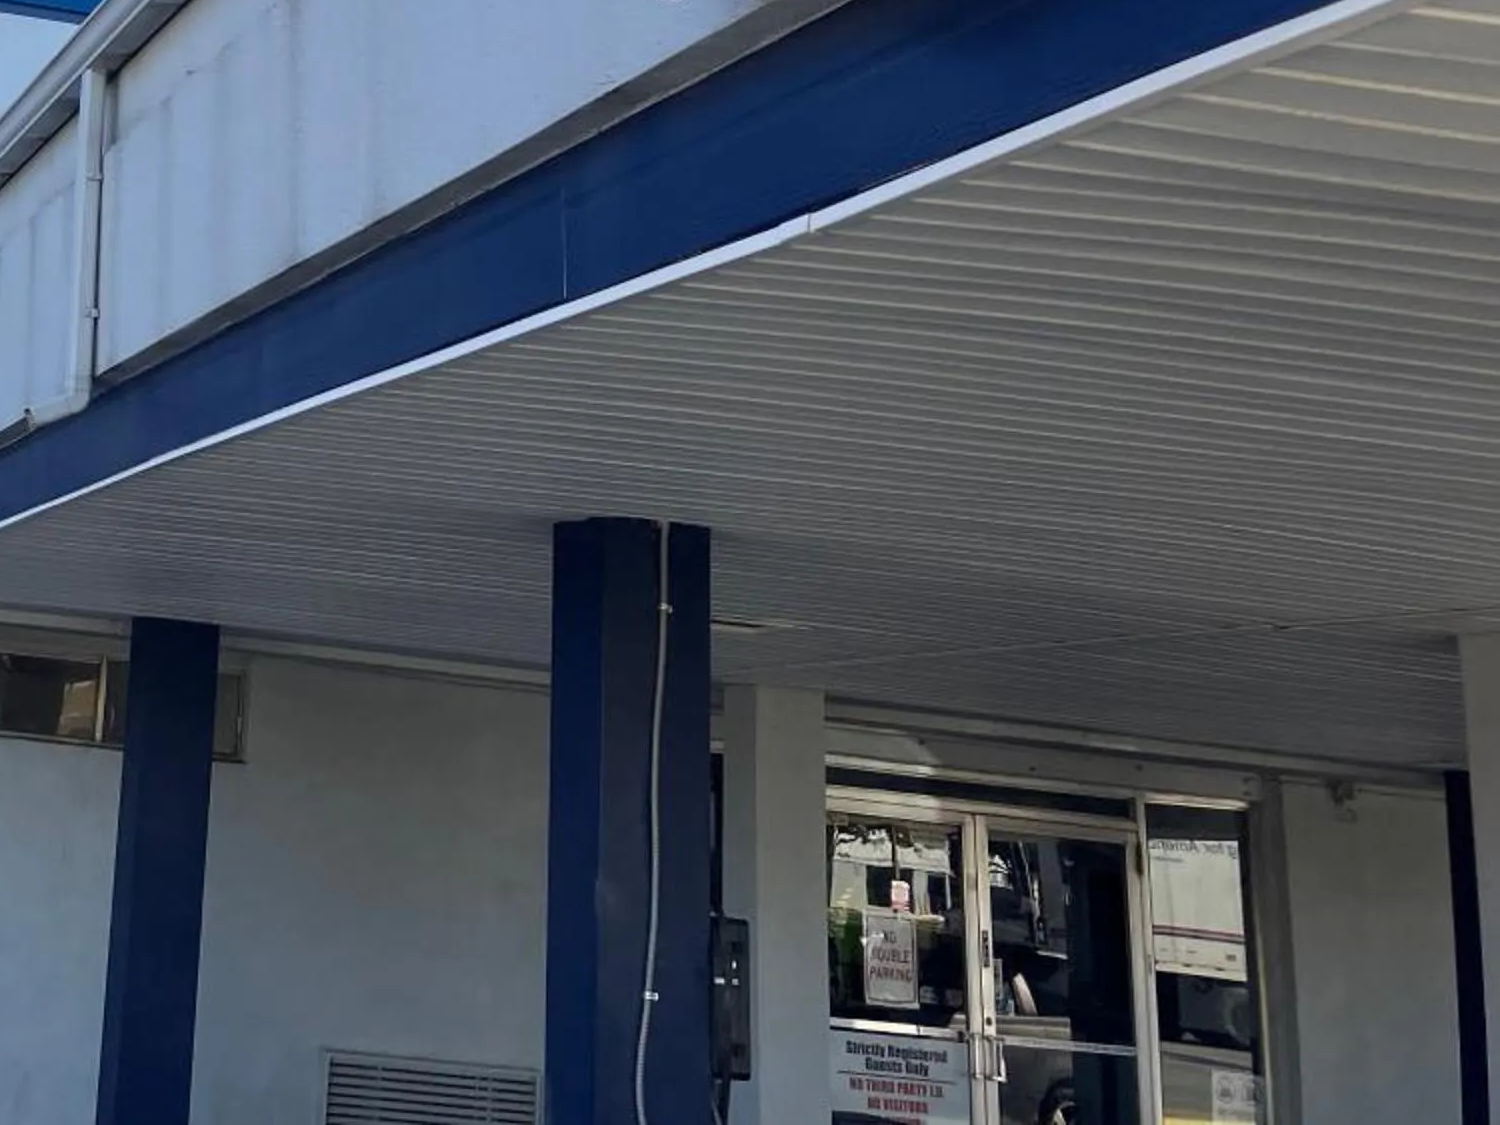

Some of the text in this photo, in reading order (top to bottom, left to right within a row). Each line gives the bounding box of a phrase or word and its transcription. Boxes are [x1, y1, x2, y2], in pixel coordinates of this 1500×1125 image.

[869, 966, 912, 982] PARKING
[846, 1040, 948, 1063] Strictly Registered
[865, 1056, 930, 1077] Guests Only
[849, 1076, 864, 1091] NO
[865, 1078, 895, 1094] THIRD
[897, 1082, 928, 1097] PARTY
